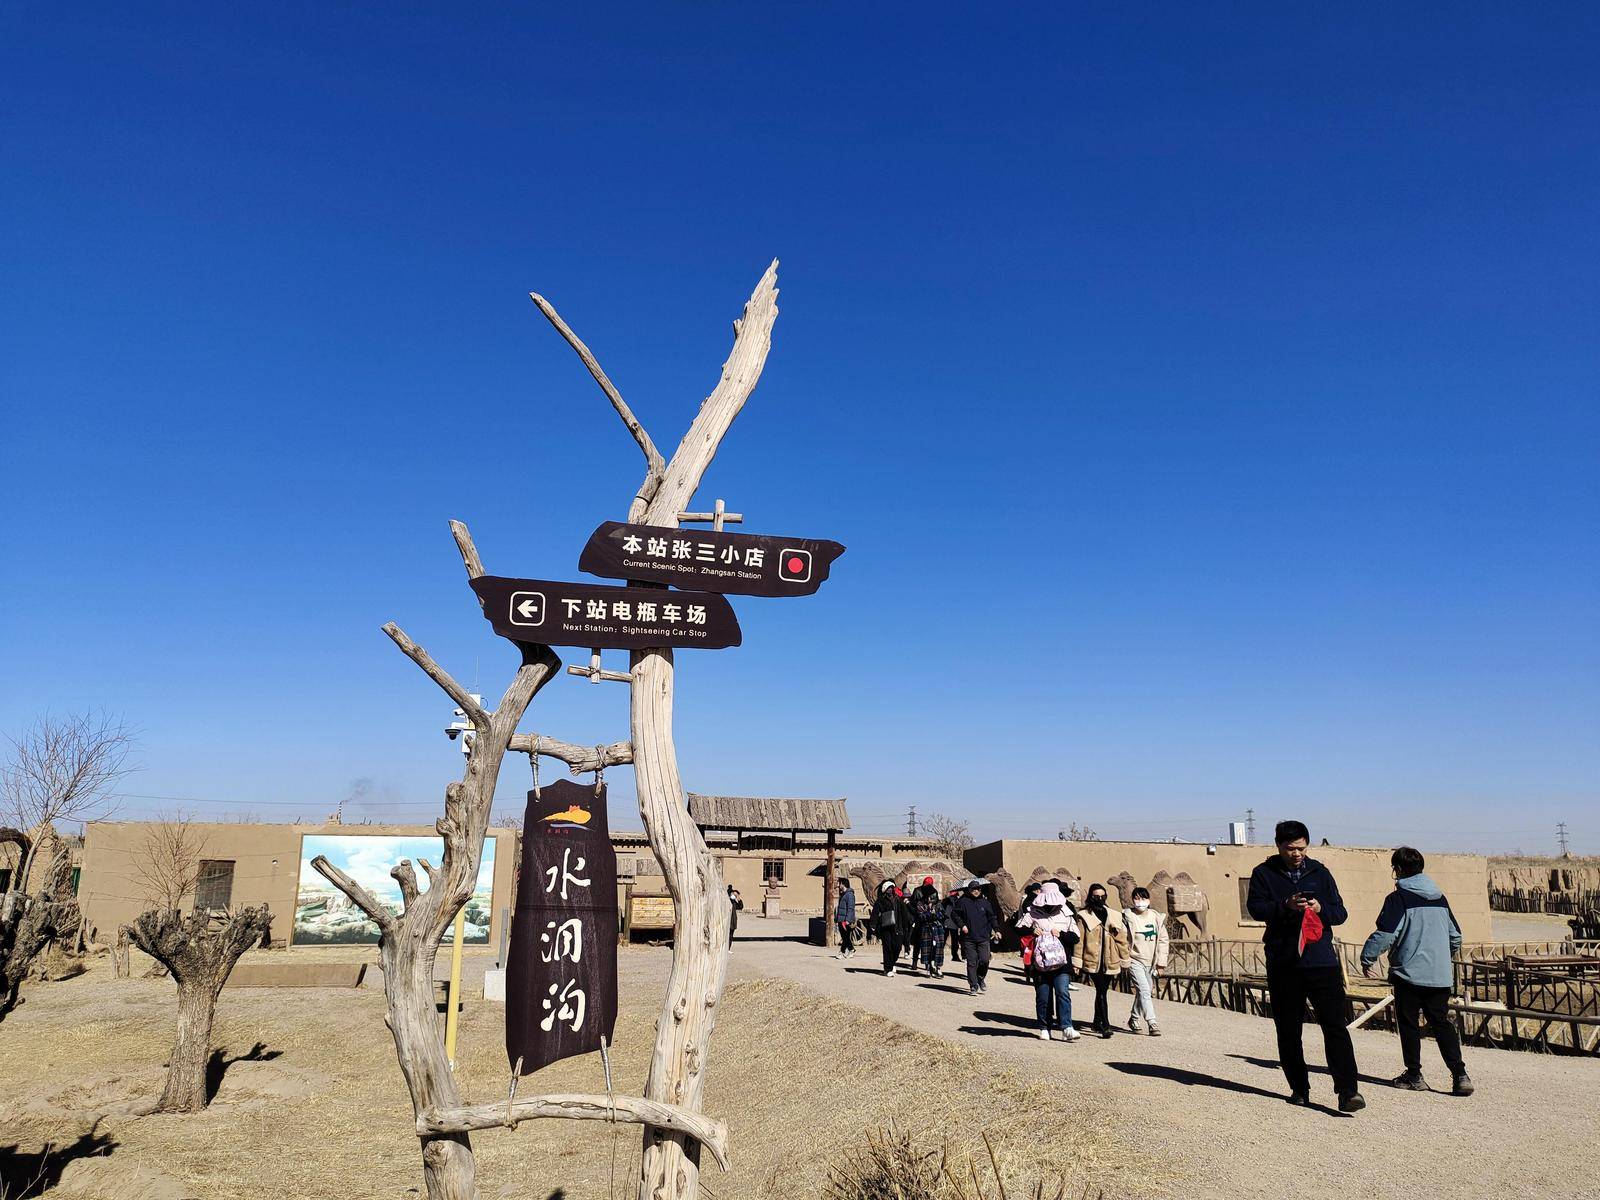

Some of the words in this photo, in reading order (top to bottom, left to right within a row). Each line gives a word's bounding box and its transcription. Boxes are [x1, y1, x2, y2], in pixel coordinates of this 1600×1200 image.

[622, 534, 765, 568] 本站张三小店
[623, 558, 651, 569] Current
[651, 562, 676, 573] Scenic
[701, 566, 736, 578] Zhangsan
[737, 570, 762, 580] Station
[561, 598, 707, 625] 下站电瓶车场
[562, 623, 582, 632] Next
[622, 625, 670, 637] Sightseeing
[672, 628, 687, 636] Car
[688, 629, 707, 638] Stop
[540, 847, 591, 1033] 水洞沟
